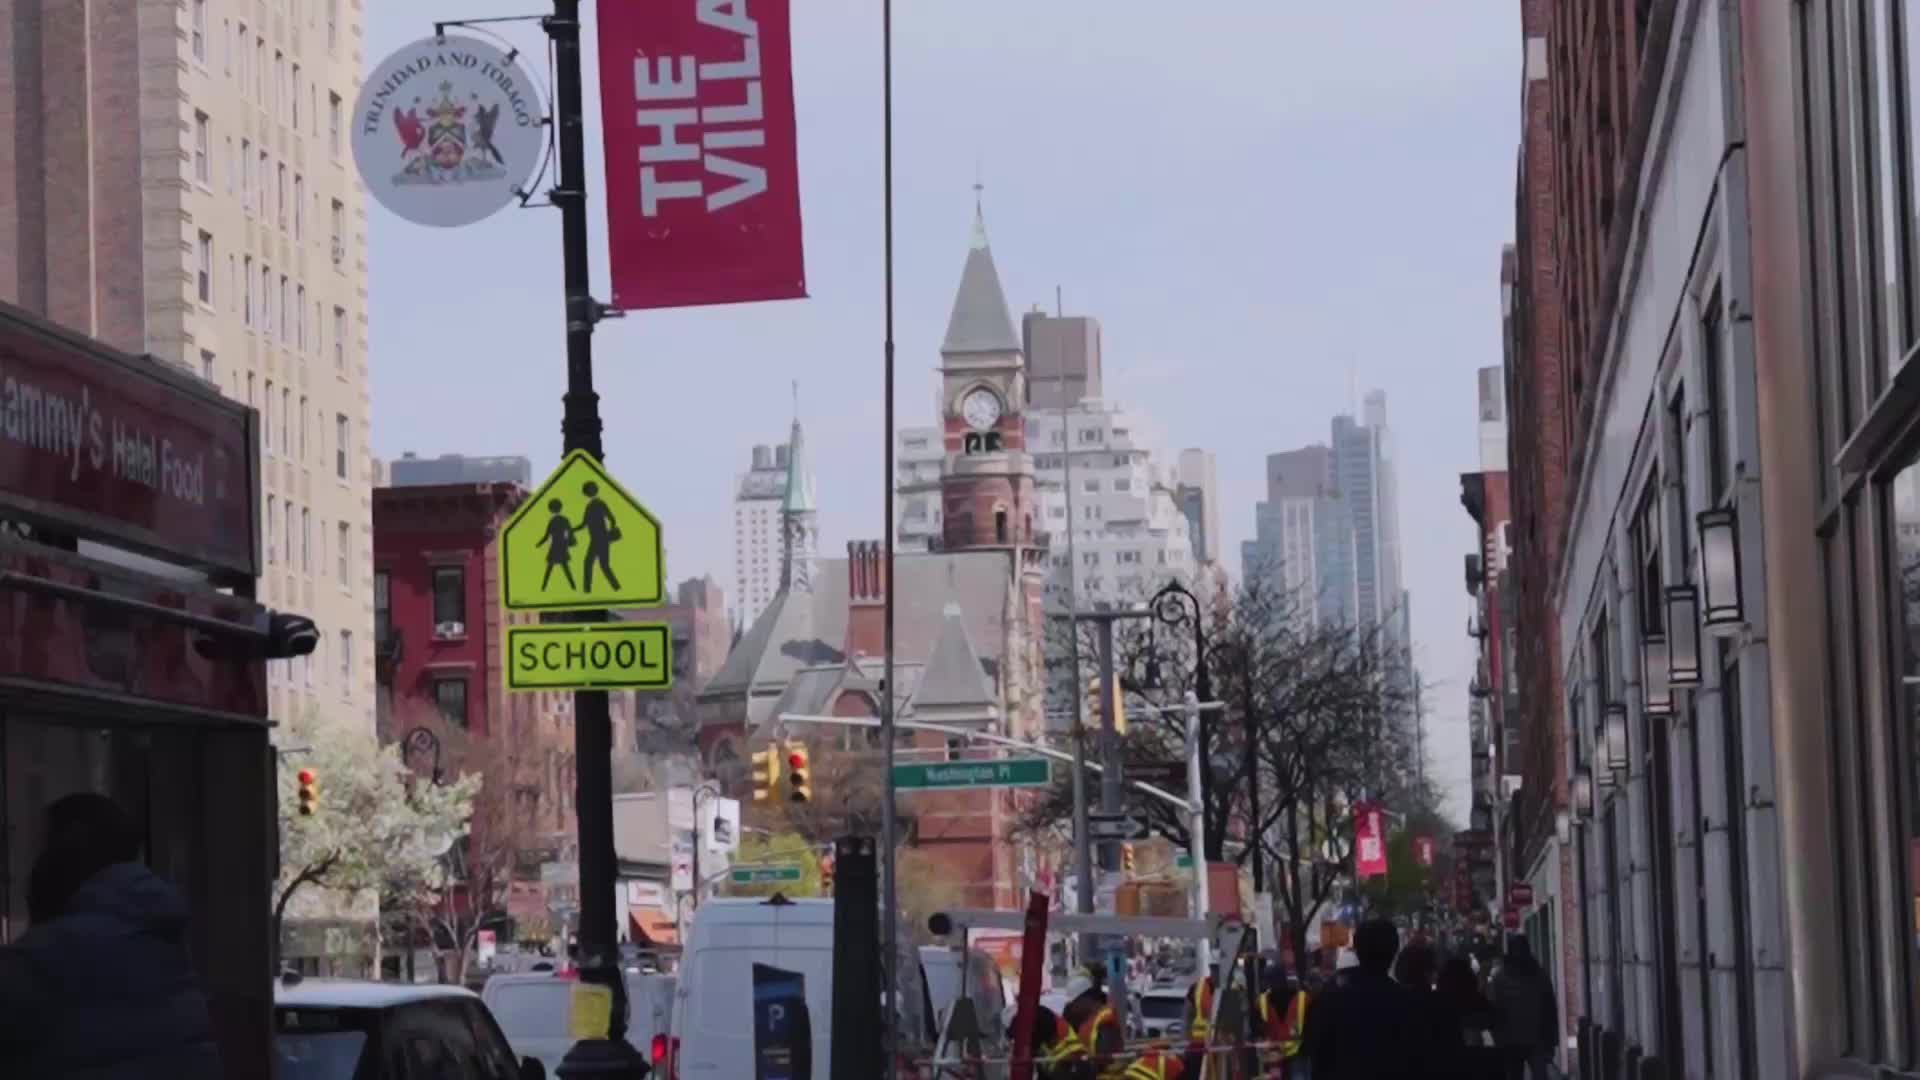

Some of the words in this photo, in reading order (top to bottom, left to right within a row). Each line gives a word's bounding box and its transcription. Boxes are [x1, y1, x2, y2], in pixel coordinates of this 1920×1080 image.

[364, 56, 431, 136] TRINIDAD
[434, 52, 478, 69] AND
[480, 61, 529, 127] TOBAGO
[635, 55, 703, 217] THE
[0, 375, 104, 482] ammy's
[112, 417, 157, 489] Halal
[161, 438, 204, 504] Food
[519, 640, 657, 671] SCHOOL
[926, 765, 993, 784] Washington
